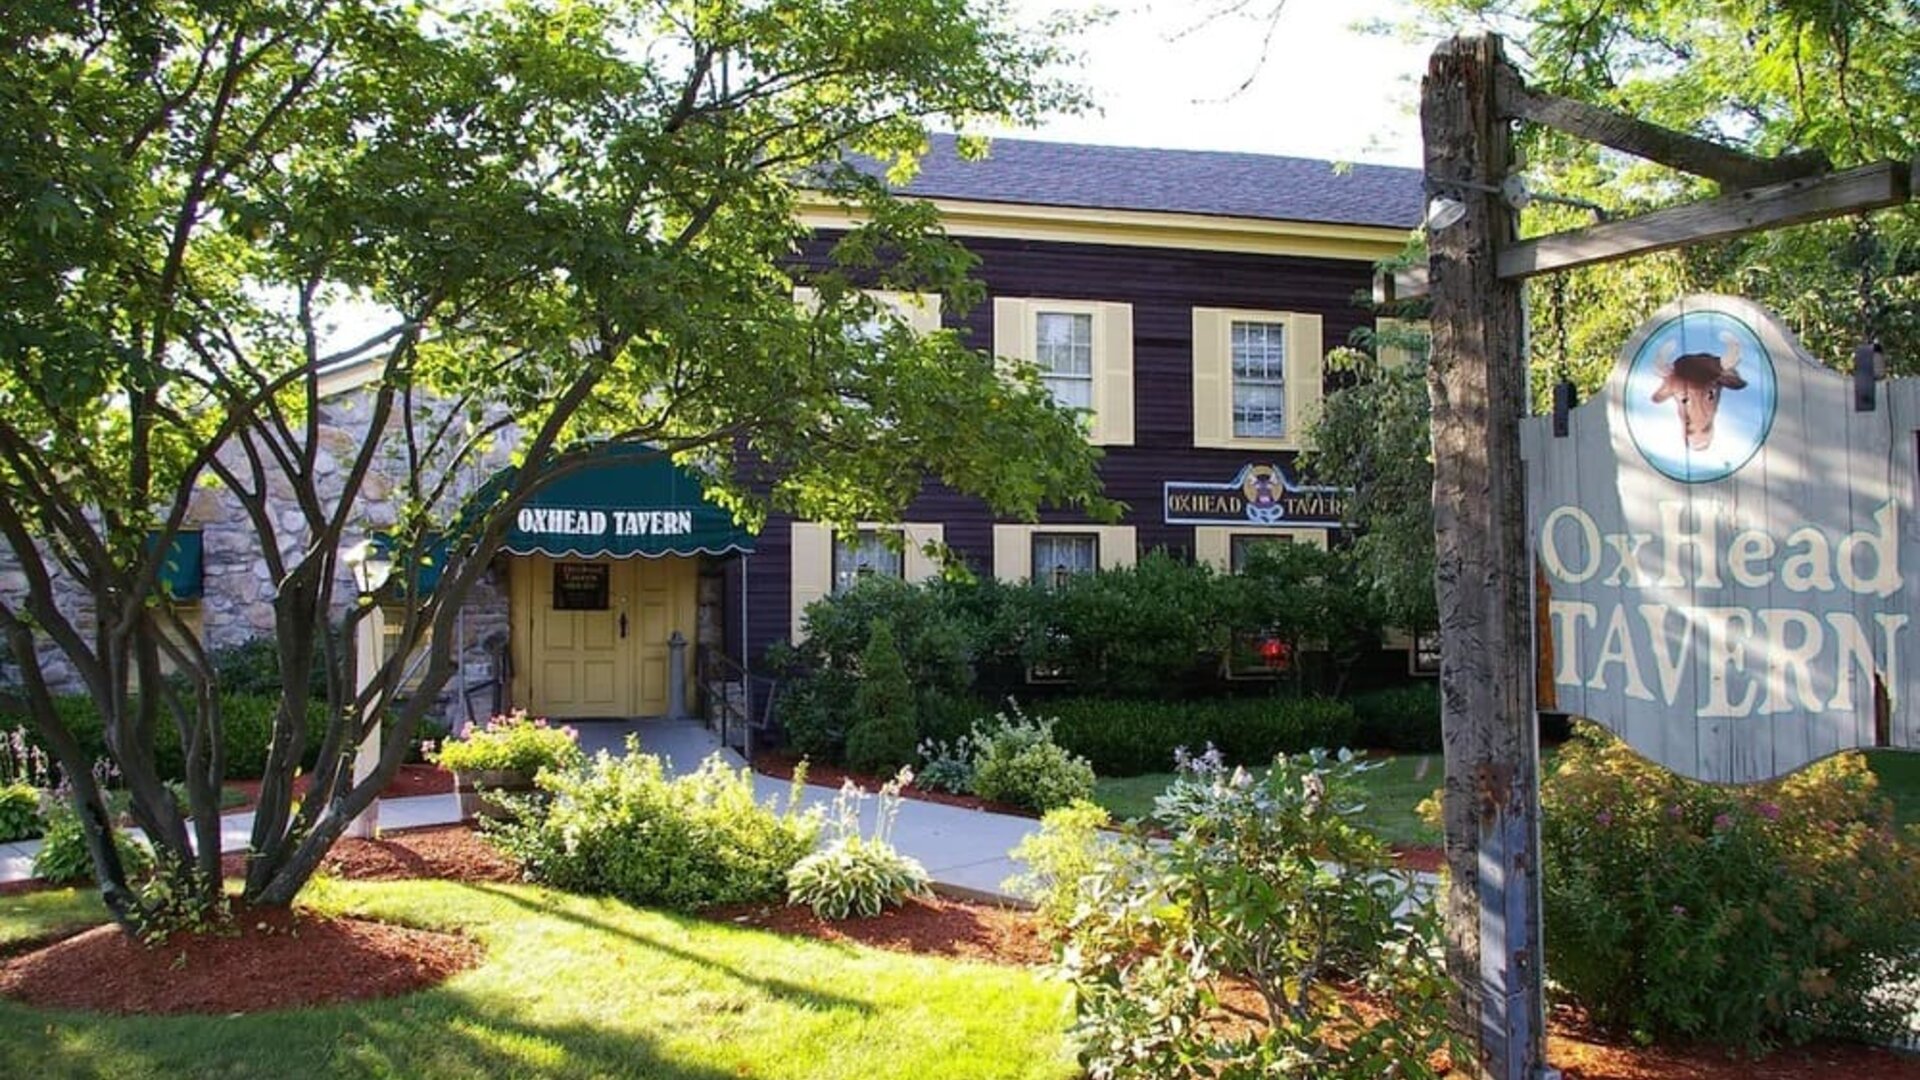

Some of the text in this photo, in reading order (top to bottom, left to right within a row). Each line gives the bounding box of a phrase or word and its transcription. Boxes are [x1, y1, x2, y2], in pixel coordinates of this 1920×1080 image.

[517, 508, 693, 536] OXHEAD TAVERN
[1168, 494, 1347, 516] OXHEAD TAVER
[1541, 500, 1904, 598] OxHead
[1549, 599, 1908, 719] TAVERN
